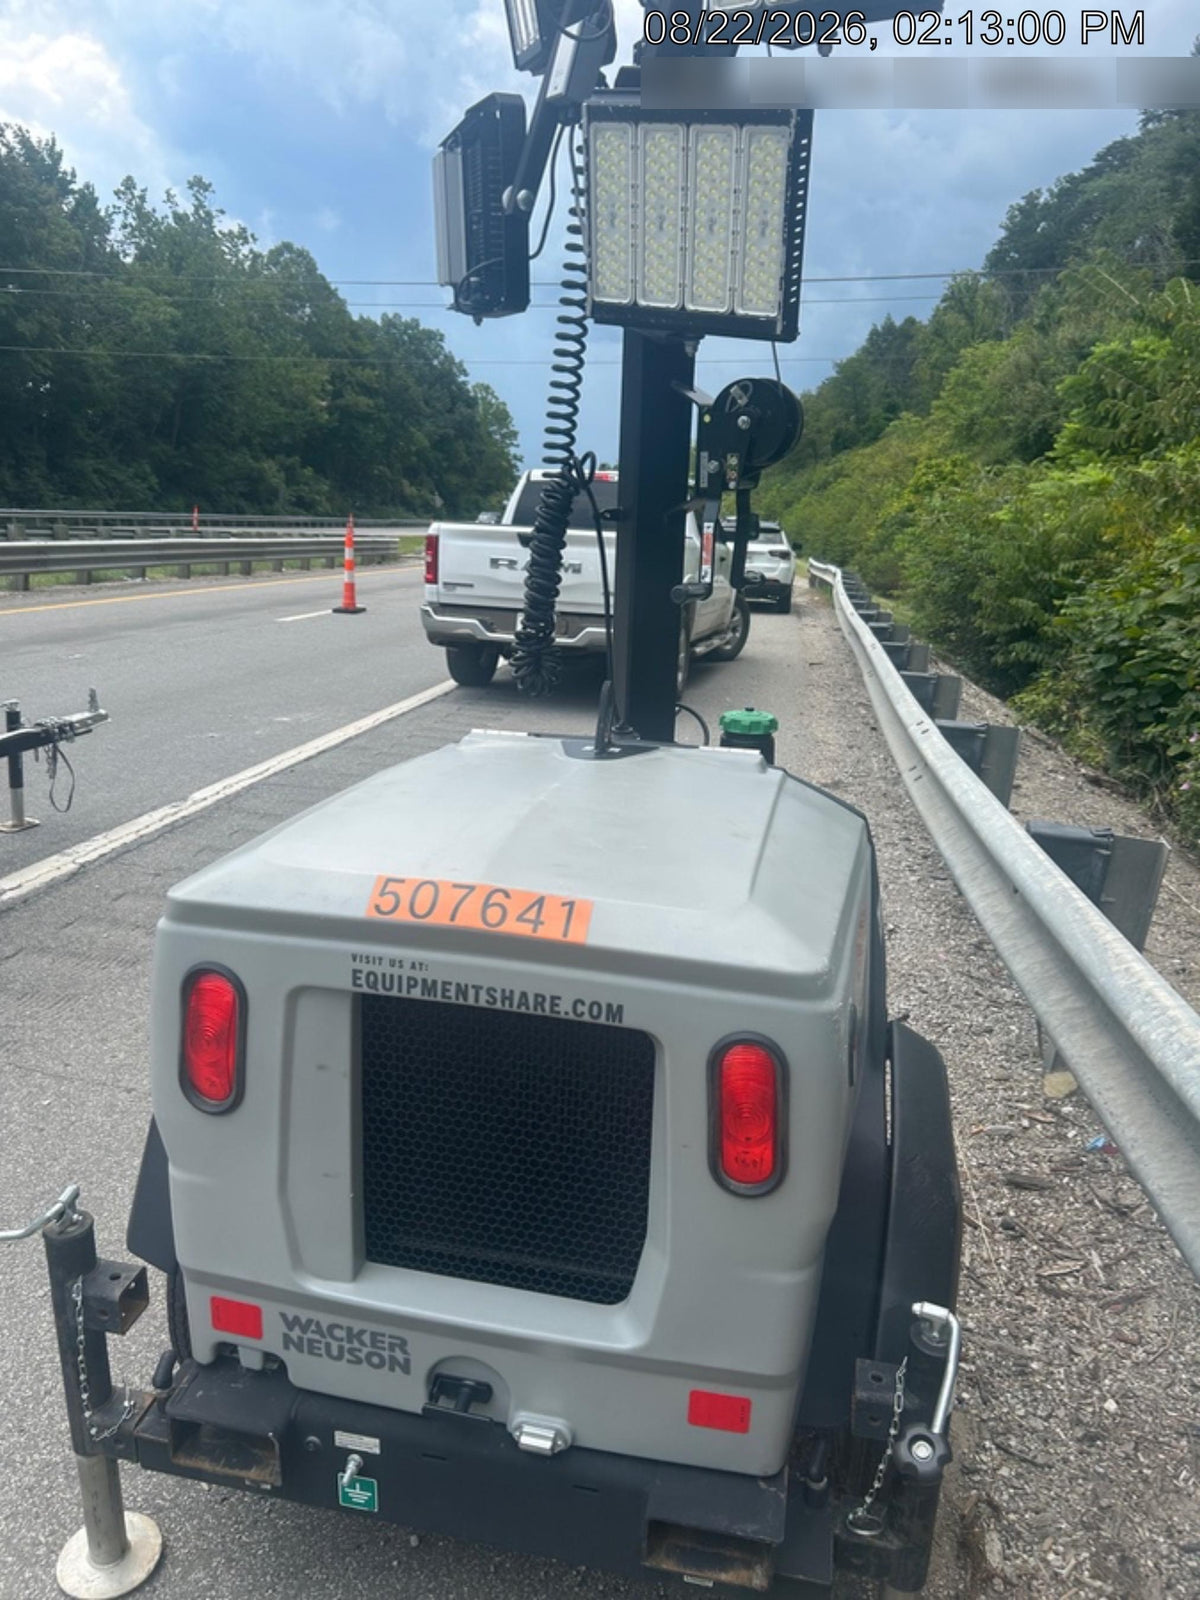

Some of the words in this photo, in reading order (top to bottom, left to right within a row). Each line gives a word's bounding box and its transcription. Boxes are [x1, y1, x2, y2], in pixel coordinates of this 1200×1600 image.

[489, 557, 582, 574] RM
[374, 877, 576, 938] 507641
[351, 953, 384, 966] VISIT
[389, 958, 404, 969] US
[410, 961, 429, 972] AT:
[351, 968, 625, 1024] EQUIPMENTSHARE.COM
[279, 1312, 411, 1355] WACKER
[282, 1333, 412, 1375] NEUSON
